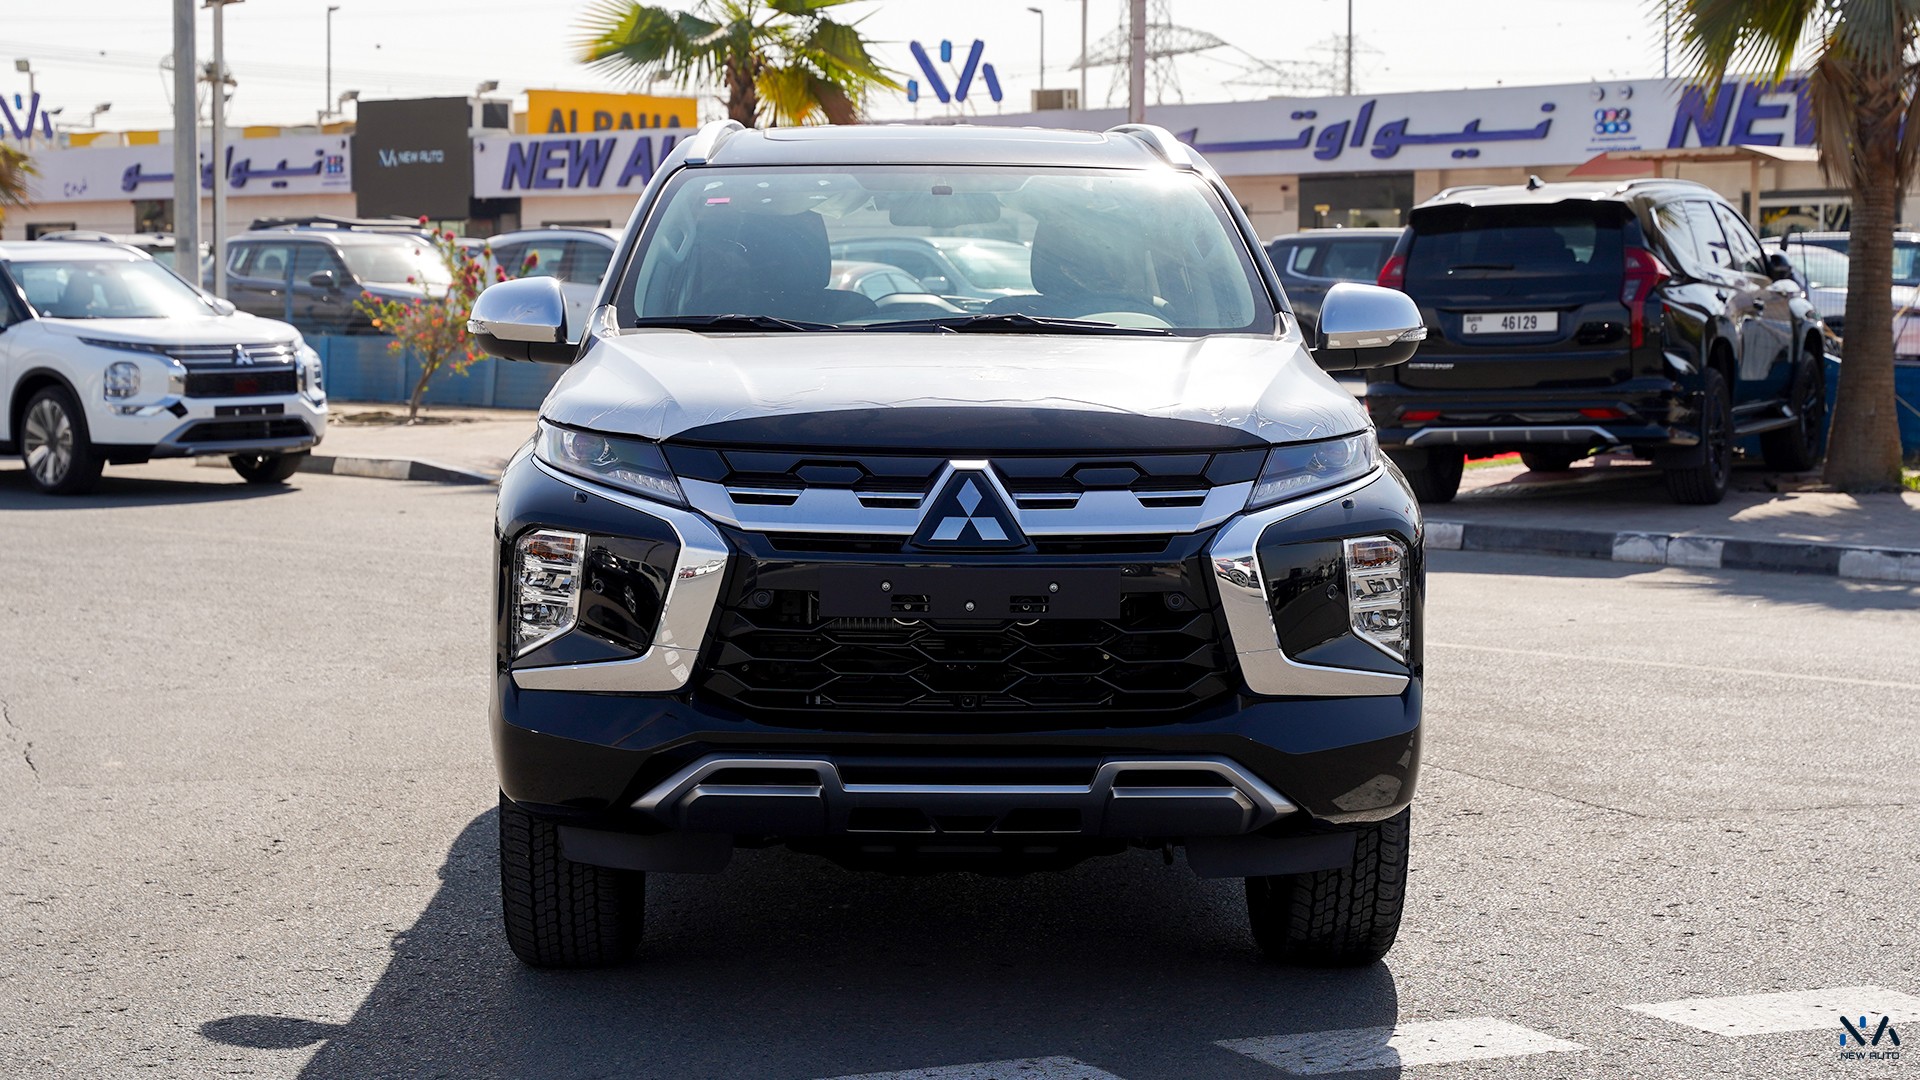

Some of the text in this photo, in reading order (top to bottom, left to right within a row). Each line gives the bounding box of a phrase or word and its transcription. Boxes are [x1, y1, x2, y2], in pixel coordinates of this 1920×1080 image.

[1667, 76, 1818, 148] NE
[398, 150, 418, 164] NEW
[419, 149, 445, 164] AUTO
[502, 136, 619, 190] NEW
[1501, 314, 1538, 330] 46129
